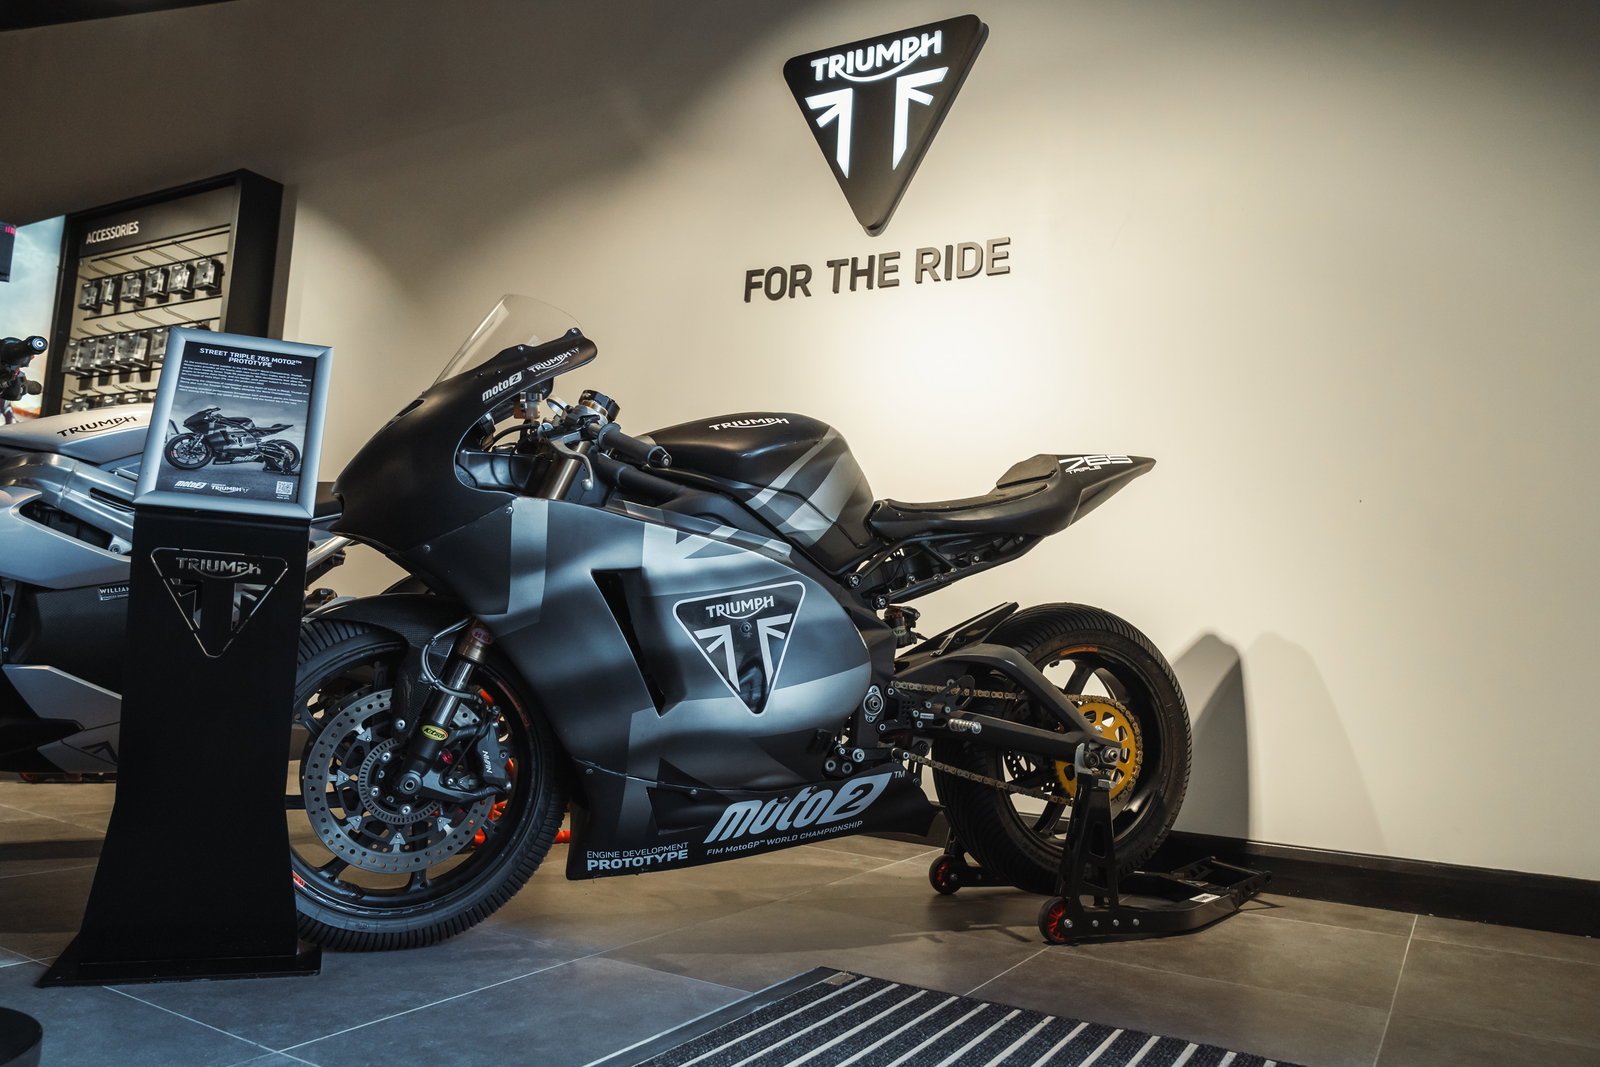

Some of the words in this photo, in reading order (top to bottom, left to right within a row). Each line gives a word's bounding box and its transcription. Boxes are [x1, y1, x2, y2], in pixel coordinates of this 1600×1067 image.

[810, 30, 942, 82] TRIUMPH
[86, 221, 140, 245] ACCESSORIES
[744, 263, 812, 303] FOR
[827, 251, 900, 294] THE
[915, 236, 1011, 284] RIDE
[199, 347, 229, 357] STREET
[230, 351, 256, 360] TRIPLE
[228, 357, 273, 368] PROTOTYPE
[527, 351, 572, 373] TRIUMPH
[57, 415, 137, 438] TRIUMPH
[709, 417, 789, 431] TRIUMPH
[1058, 454, 1134, 472] 765
[211, 485, 242, 494] TRIUMPH
[175, 556, 262, 579] TRIUMPH
[705, 595, 775, 620] TRIUMPH
[706, 847, 724, 856] FIM
[766, 834, 798, 846] WORLD
[799, 820, 863, 840] CHAMPIONSHIP
[586, 850, 620, 859] ENGINE
[622, 841, 689, 858] DEVELOPMENT
[587, 849, 689, 872] PROTOTYPE
